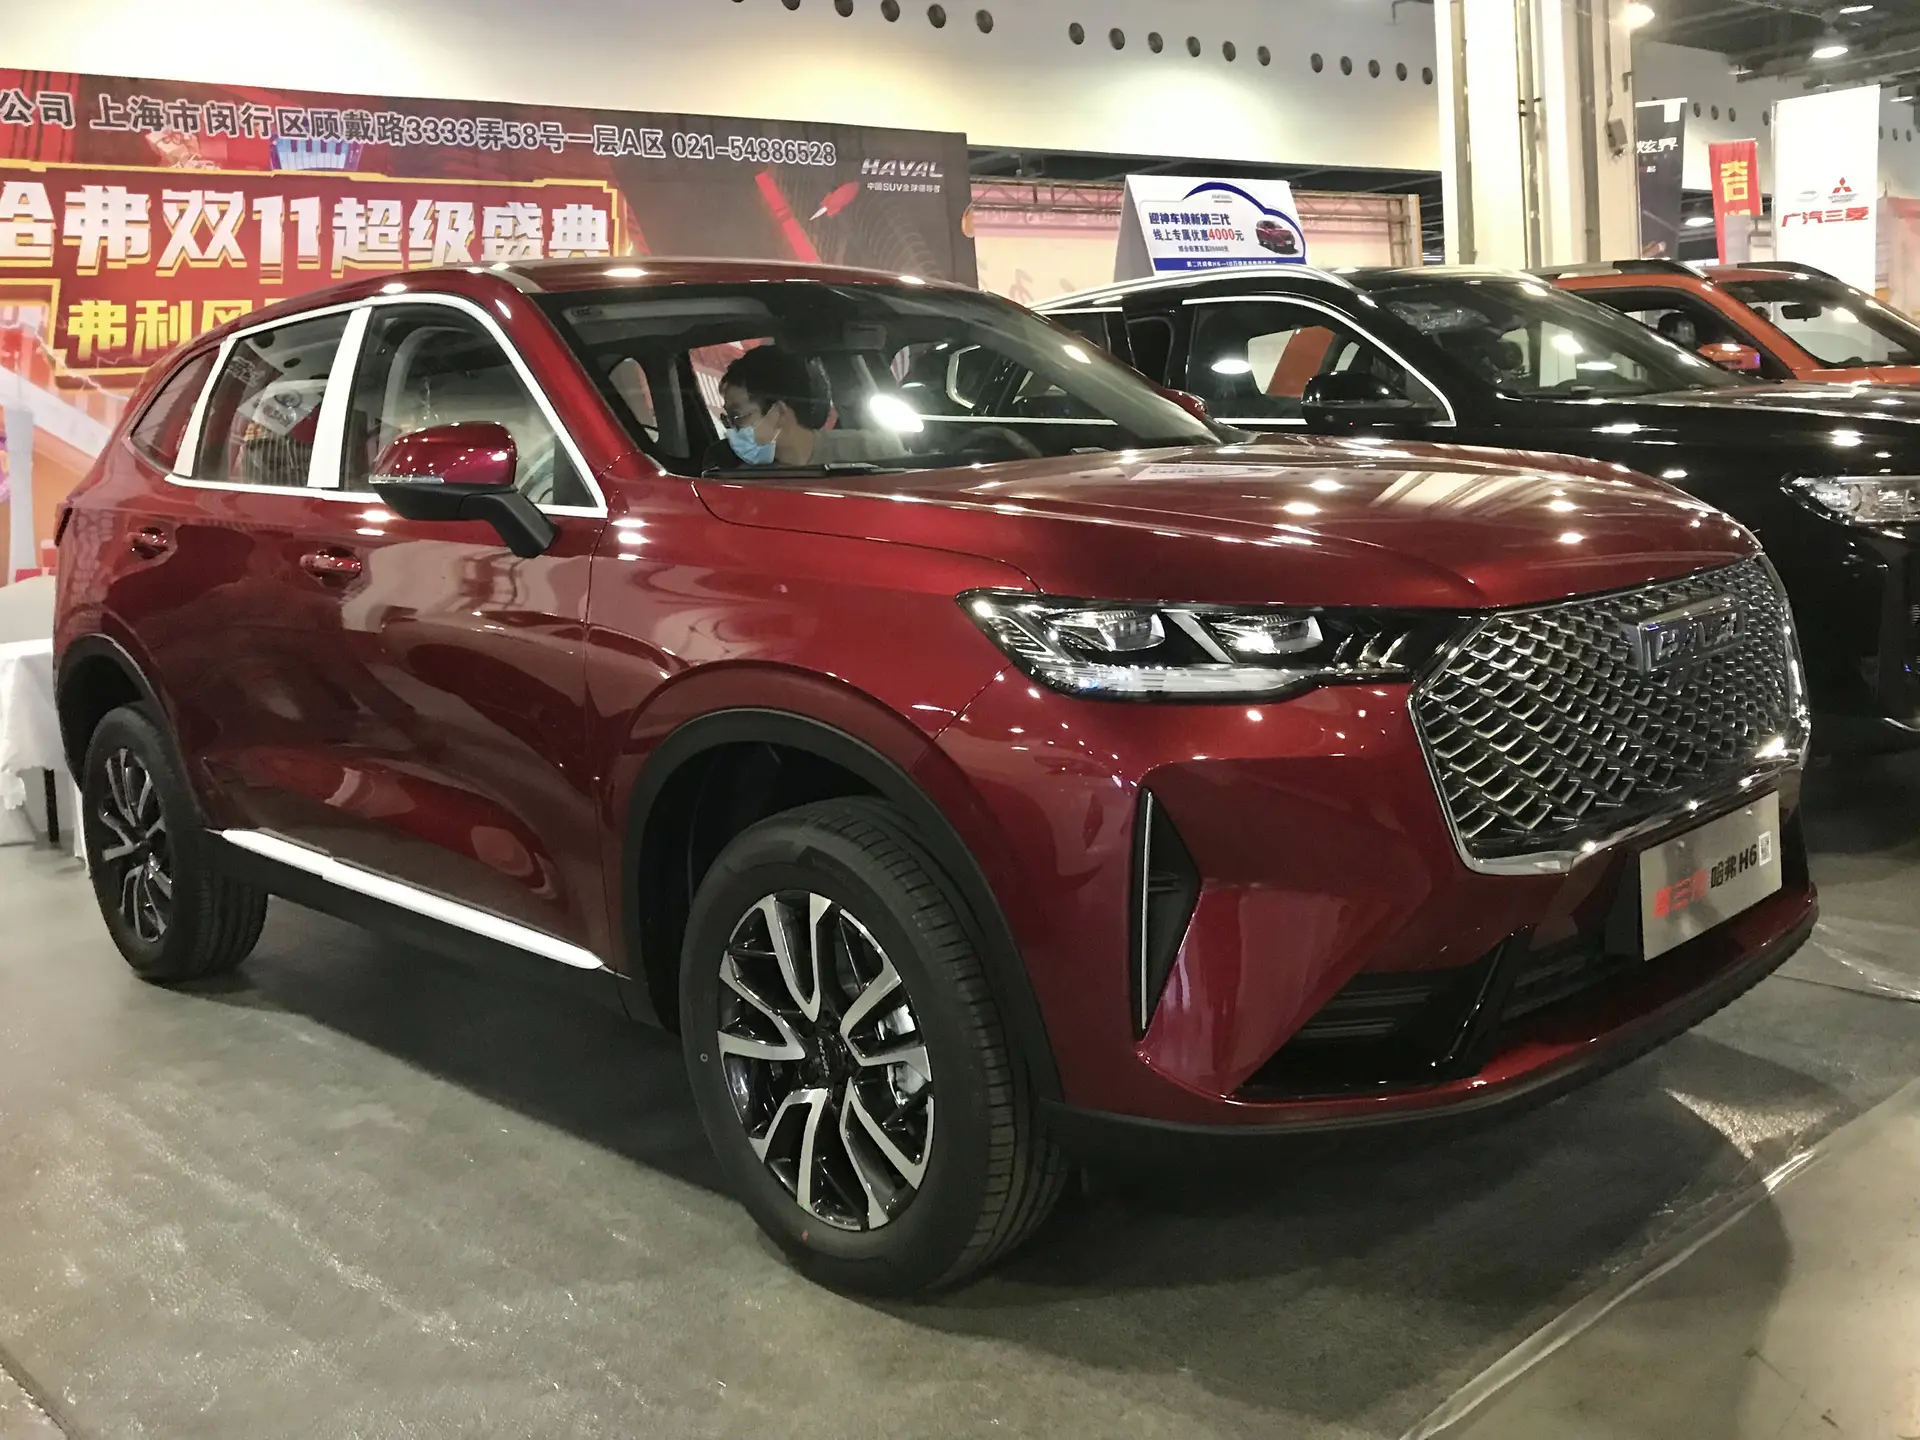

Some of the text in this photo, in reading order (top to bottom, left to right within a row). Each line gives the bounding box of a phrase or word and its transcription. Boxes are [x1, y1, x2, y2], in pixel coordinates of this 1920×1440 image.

[0, 88, 837, 166] 公司 上海市闵行区顾戴路3333弄58号一层A区 021-54886528
[861, 158, 944, 178] HAVAL
[1152, 228, 1245, 242] 线上专属优惠4000元
